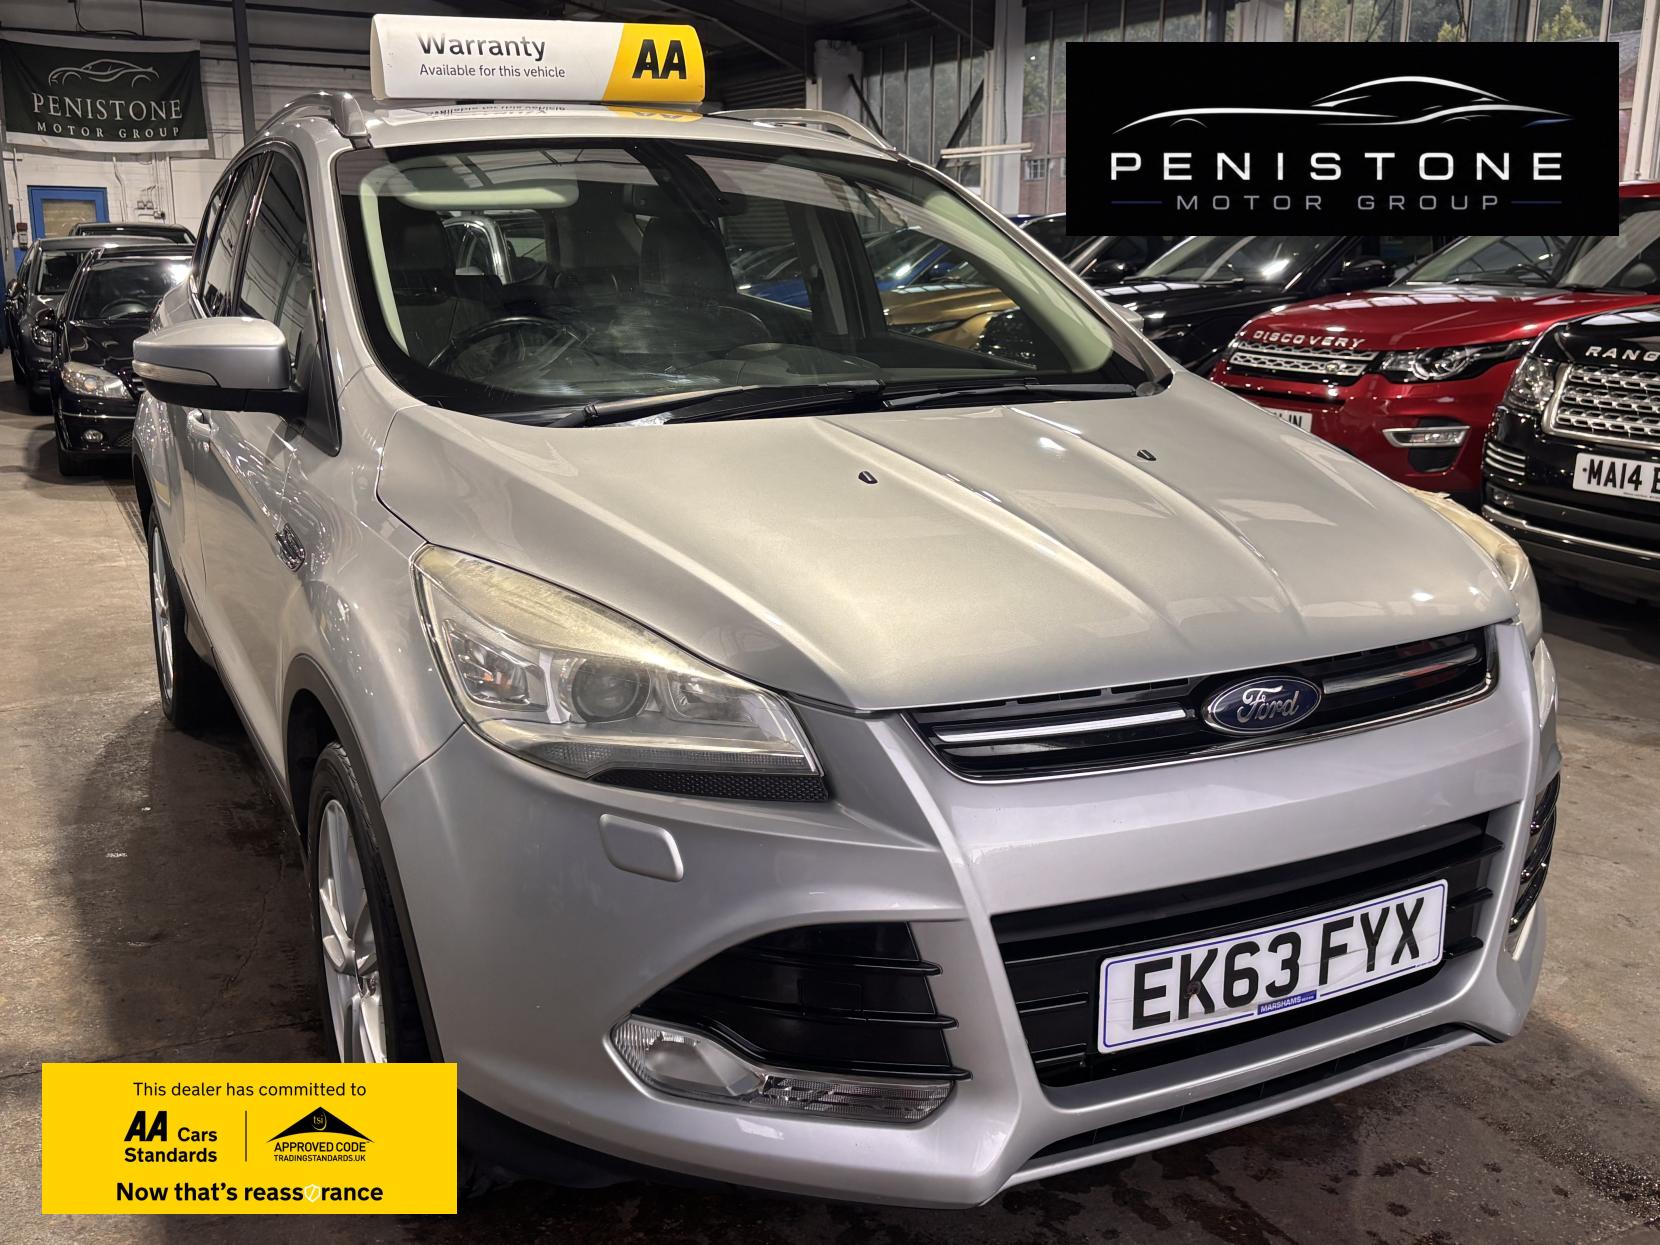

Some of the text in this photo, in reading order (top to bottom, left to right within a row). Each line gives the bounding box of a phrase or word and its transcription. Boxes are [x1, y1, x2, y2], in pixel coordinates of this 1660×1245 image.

[417, 32, 546, 61] Warranty
[632, 39, 688, 80] AA
[419, 64, 566, 78] Available for this vehicle
[32, 92, 183, 122] PENISTONE
[37, 121, 181, 138] MOTOR GROUP
[1253, 330, 1366, 348] DISCOVERY
[1587, 458, 1643, 491] MA14
[1237, 685, 1300, 723] Ford
[1132, 896, 1425, 1031] EK63 FYX
[1260, 996, 1302, 1013] MARSHAMS
